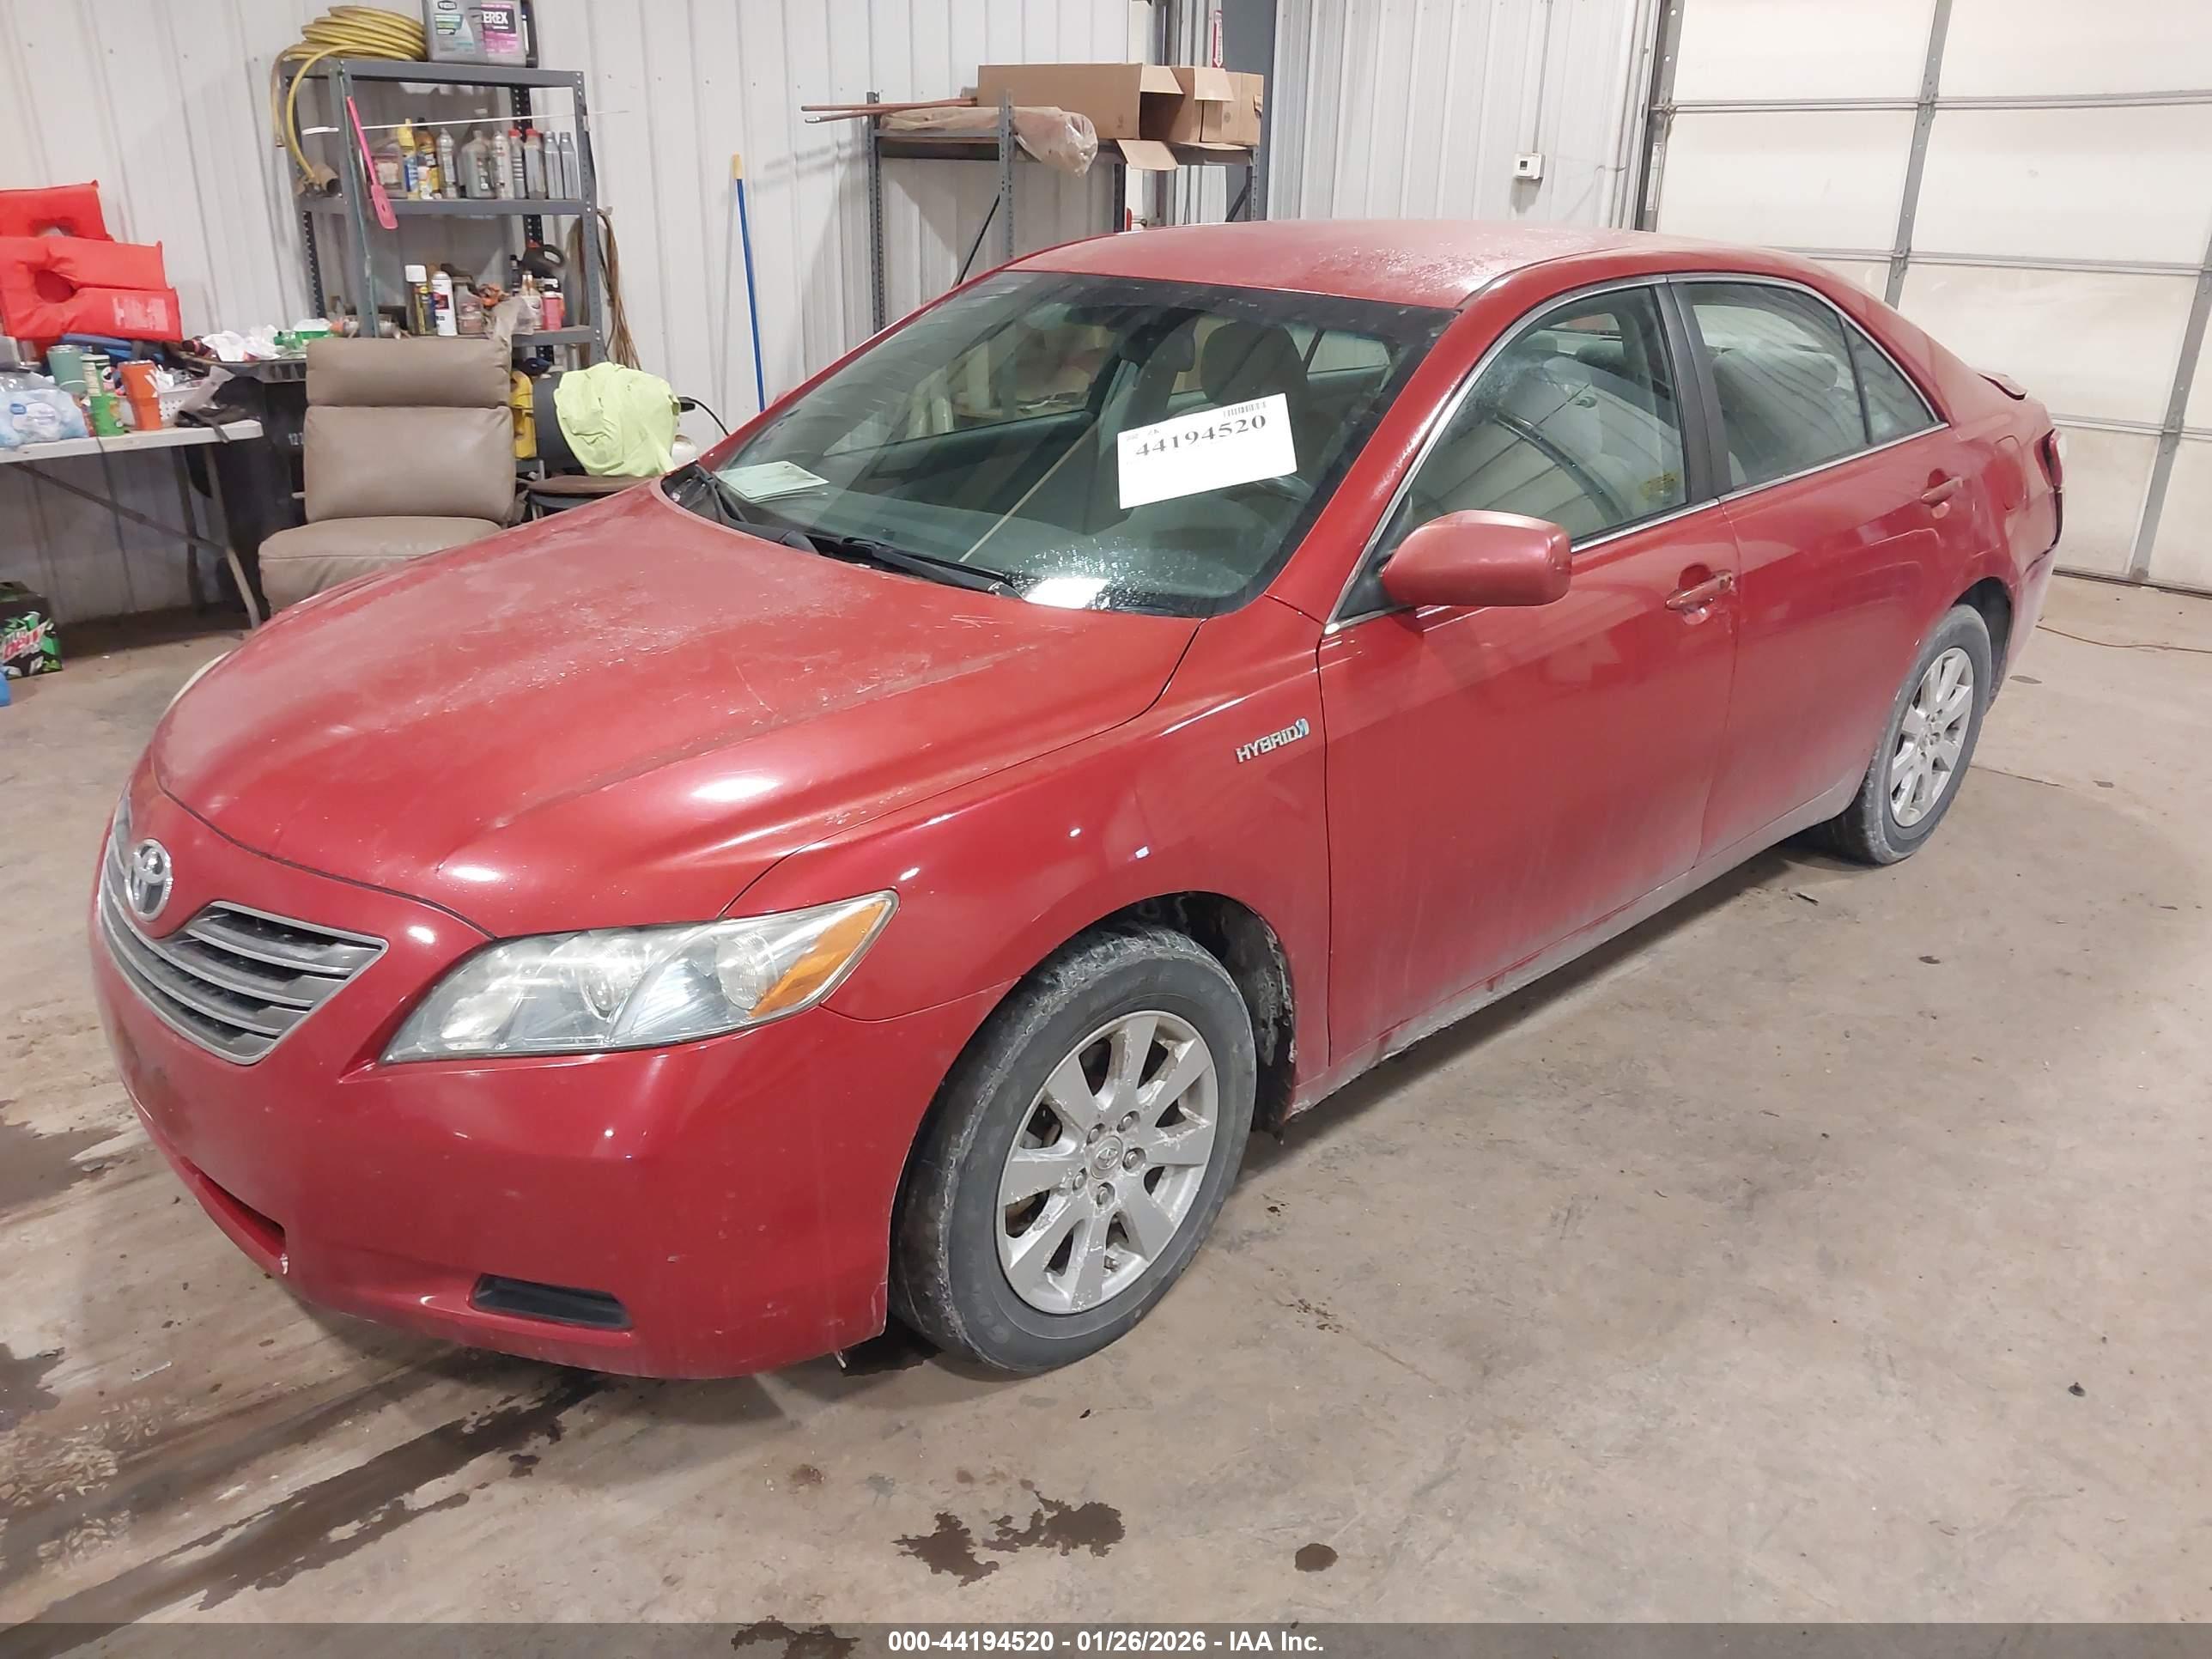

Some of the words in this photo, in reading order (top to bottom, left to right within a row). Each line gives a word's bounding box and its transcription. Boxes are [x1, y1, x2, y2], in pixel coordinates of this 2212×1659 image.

[477, 10, 509, 24] EREX
[1135, 415, 1267, 456] 44194520
[1236, 725, 1302, 763] HYBRID
